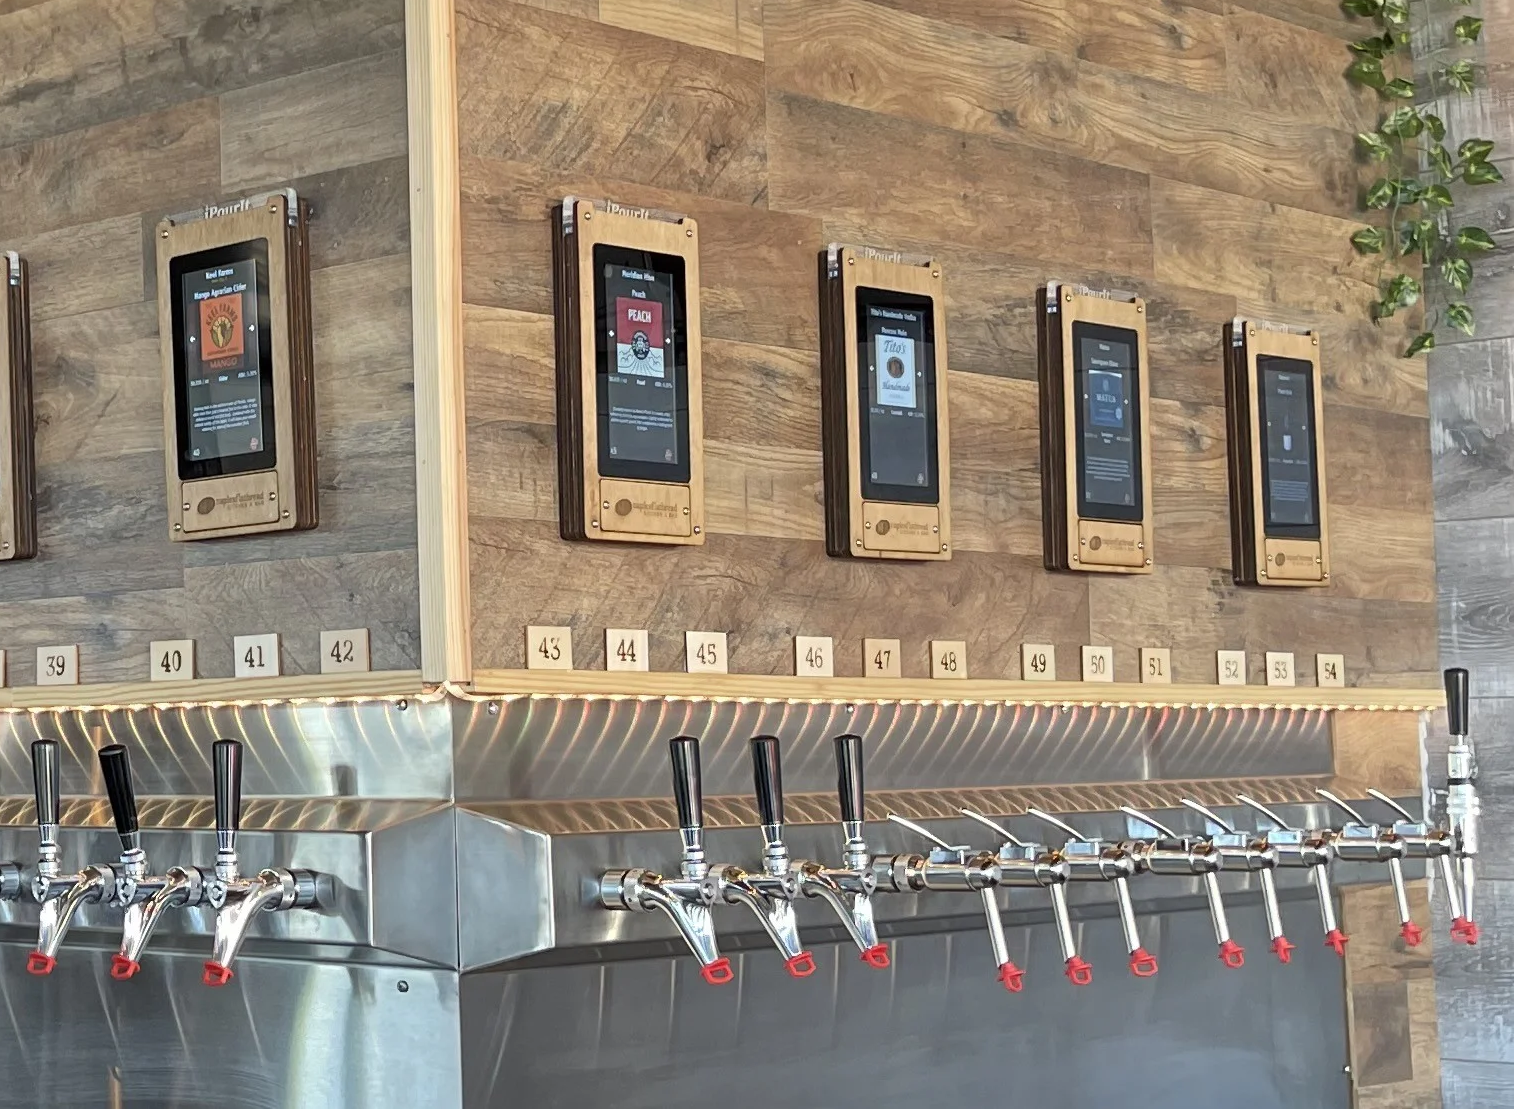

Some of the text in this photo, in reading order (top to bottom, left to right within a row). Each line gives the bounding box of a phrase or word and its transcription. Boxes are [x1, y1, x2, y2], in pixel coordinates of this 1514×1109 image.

[205, 198, 250, 219] iPourIt
[606, 199, 650, 219] iPourIt
[628, 308, 652, 323] PEACH
[883, 339, 907, 354] Tito's
[210, 357, 238, 369] MANGO
[244, 645, 265, 668] 41
[330, 639, 354, 664] 42
[538, 636, 561, 661] 43
[616, 638, 637, 663] 44
[696, 642, 717, 665] 45
[805, 646, 824, 669] 46
[46, 655, 66, 677] 39
[160, 649, 182, 673] 40
[874, 649, 891, 670] 47
[940, 651, 957, 672] 48
[1030, 653, 1047, 674] 49
[1090, 654, 1106, 675] 50
[1149, 657, 1163, 677] 51
[1224, 659, 1239, 679] 52
[1274, 660, 1288, 680] 53
[1324, 662, 1337, 680] 54
